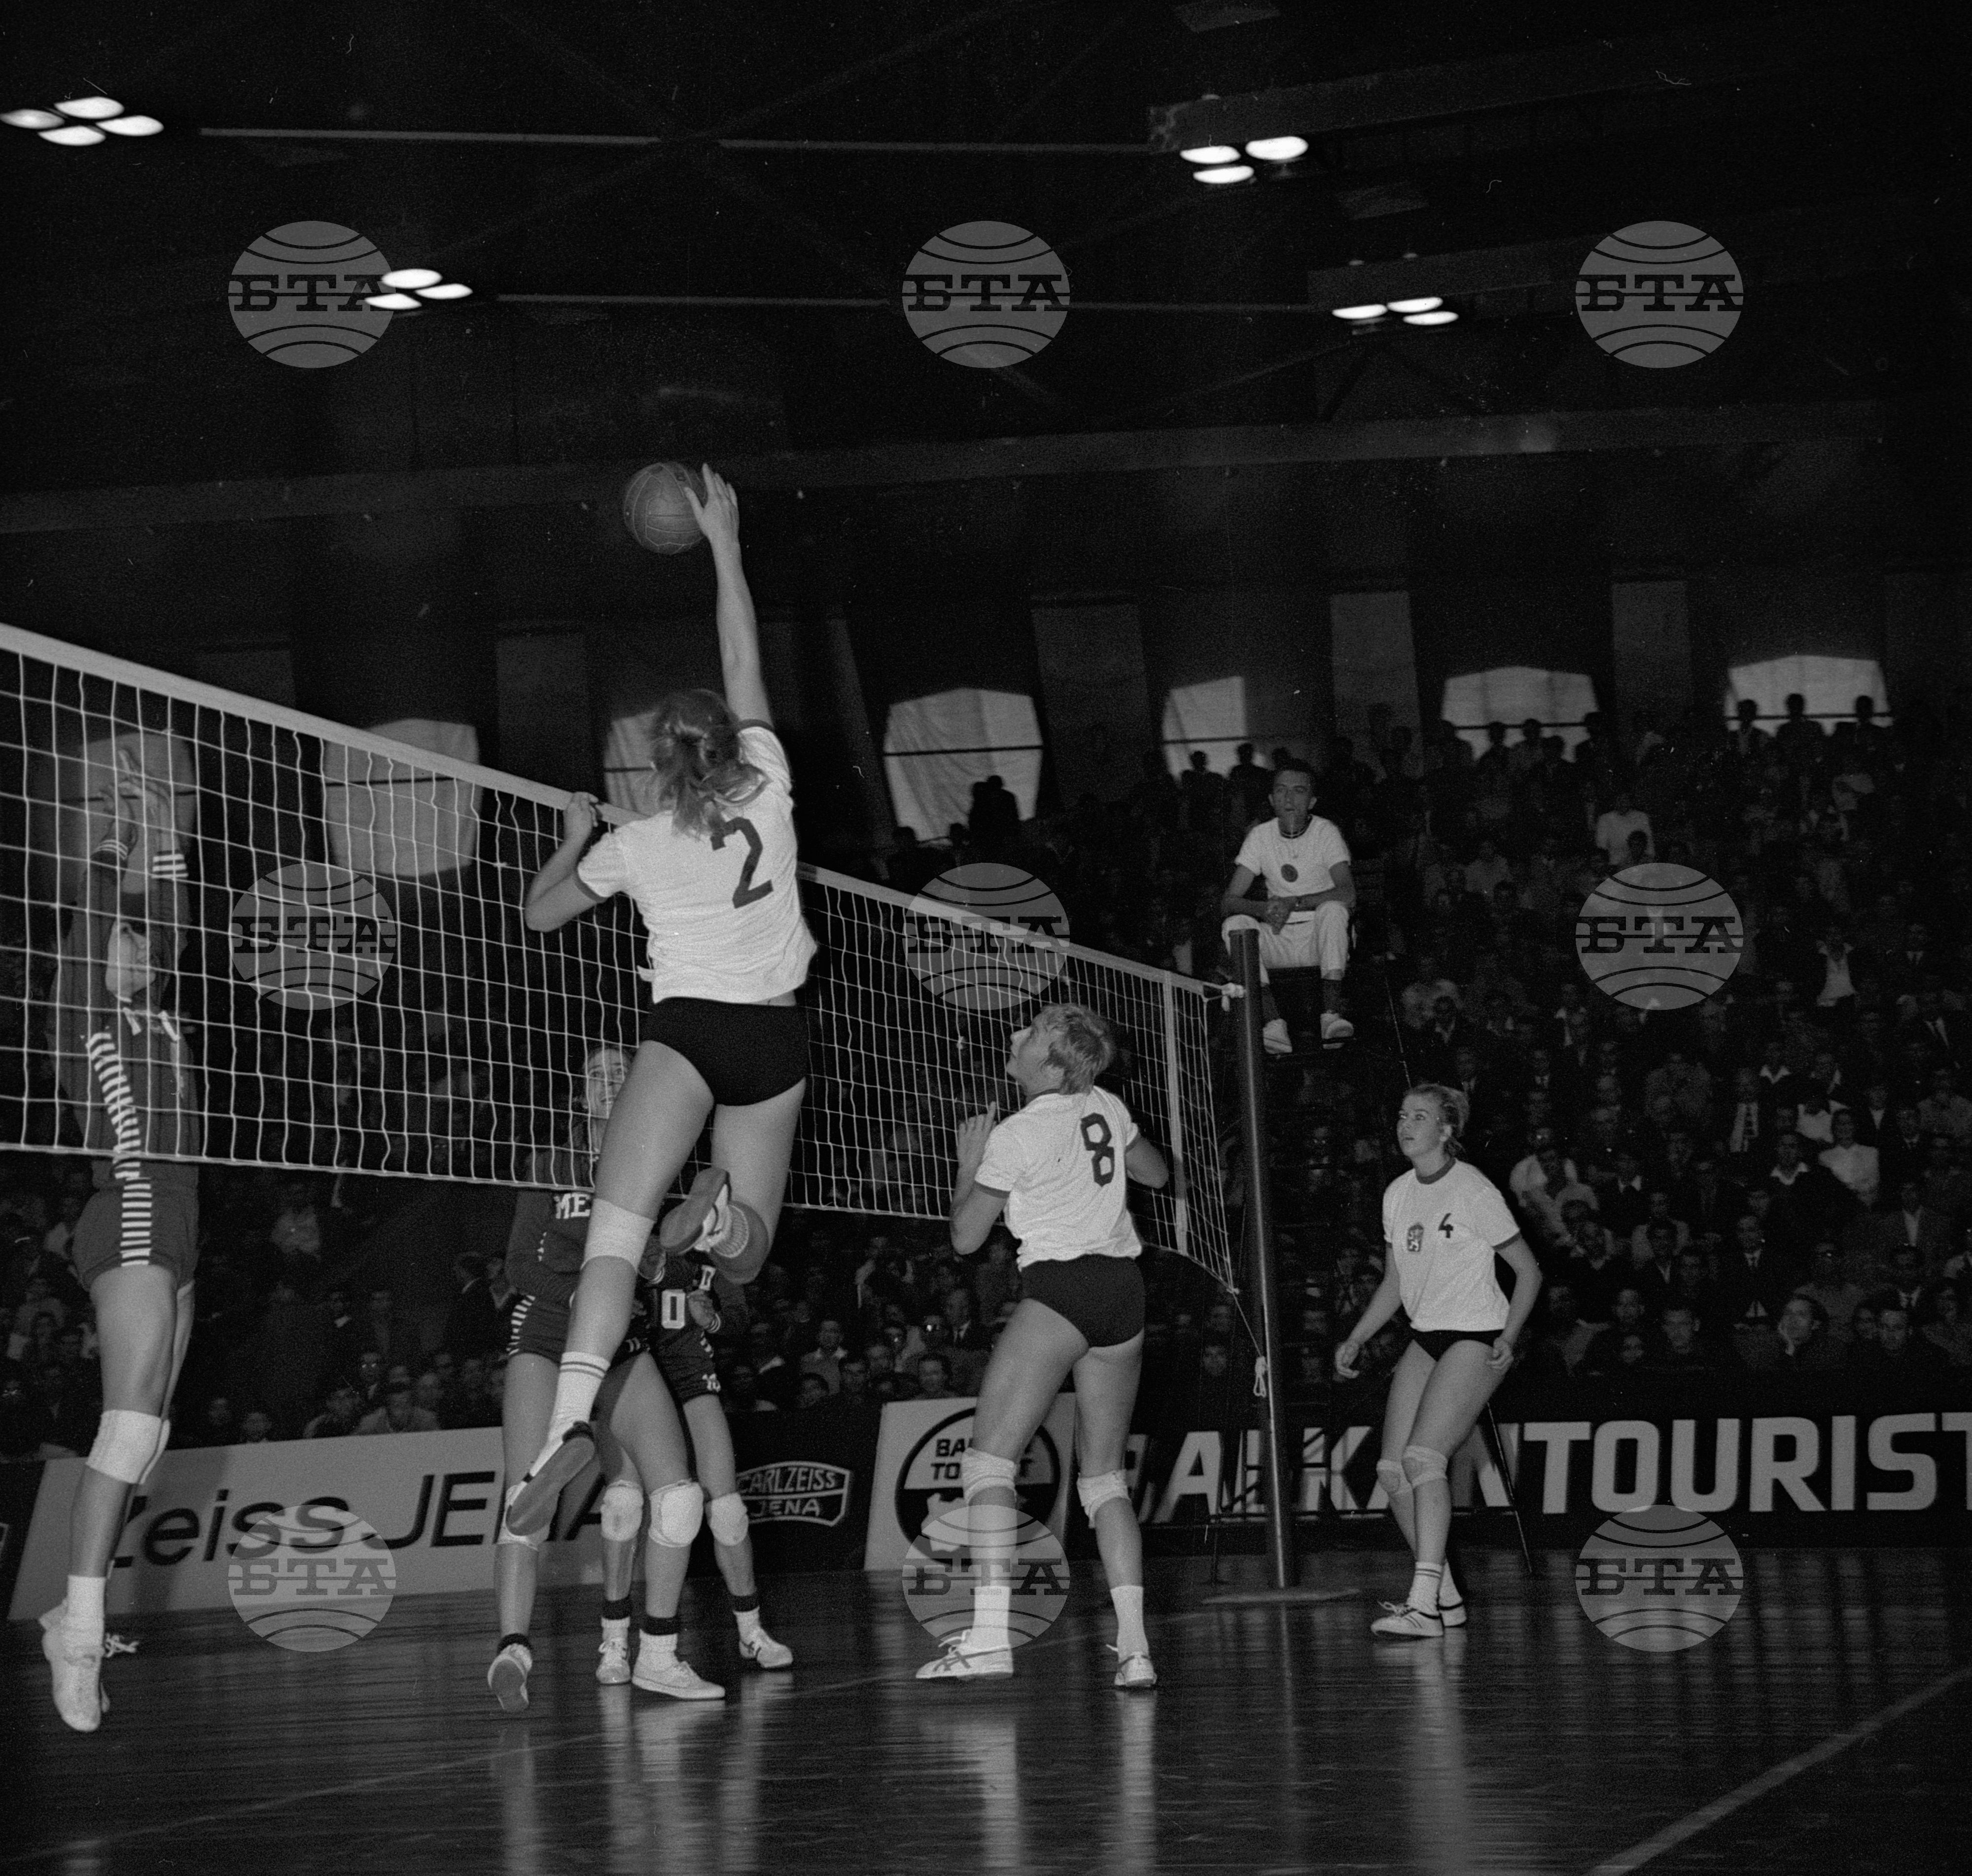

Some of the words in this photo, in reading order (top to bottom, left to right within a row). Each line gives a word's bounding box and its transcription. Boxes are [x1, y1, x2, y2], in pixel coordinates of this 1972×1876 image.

[710, 817, 774, 909] 2
[1080, 1112, 1115, 1187] 8
[1438, 1213, 1453, 1238] 4
[749, 1498, 820, 1517] JENA
